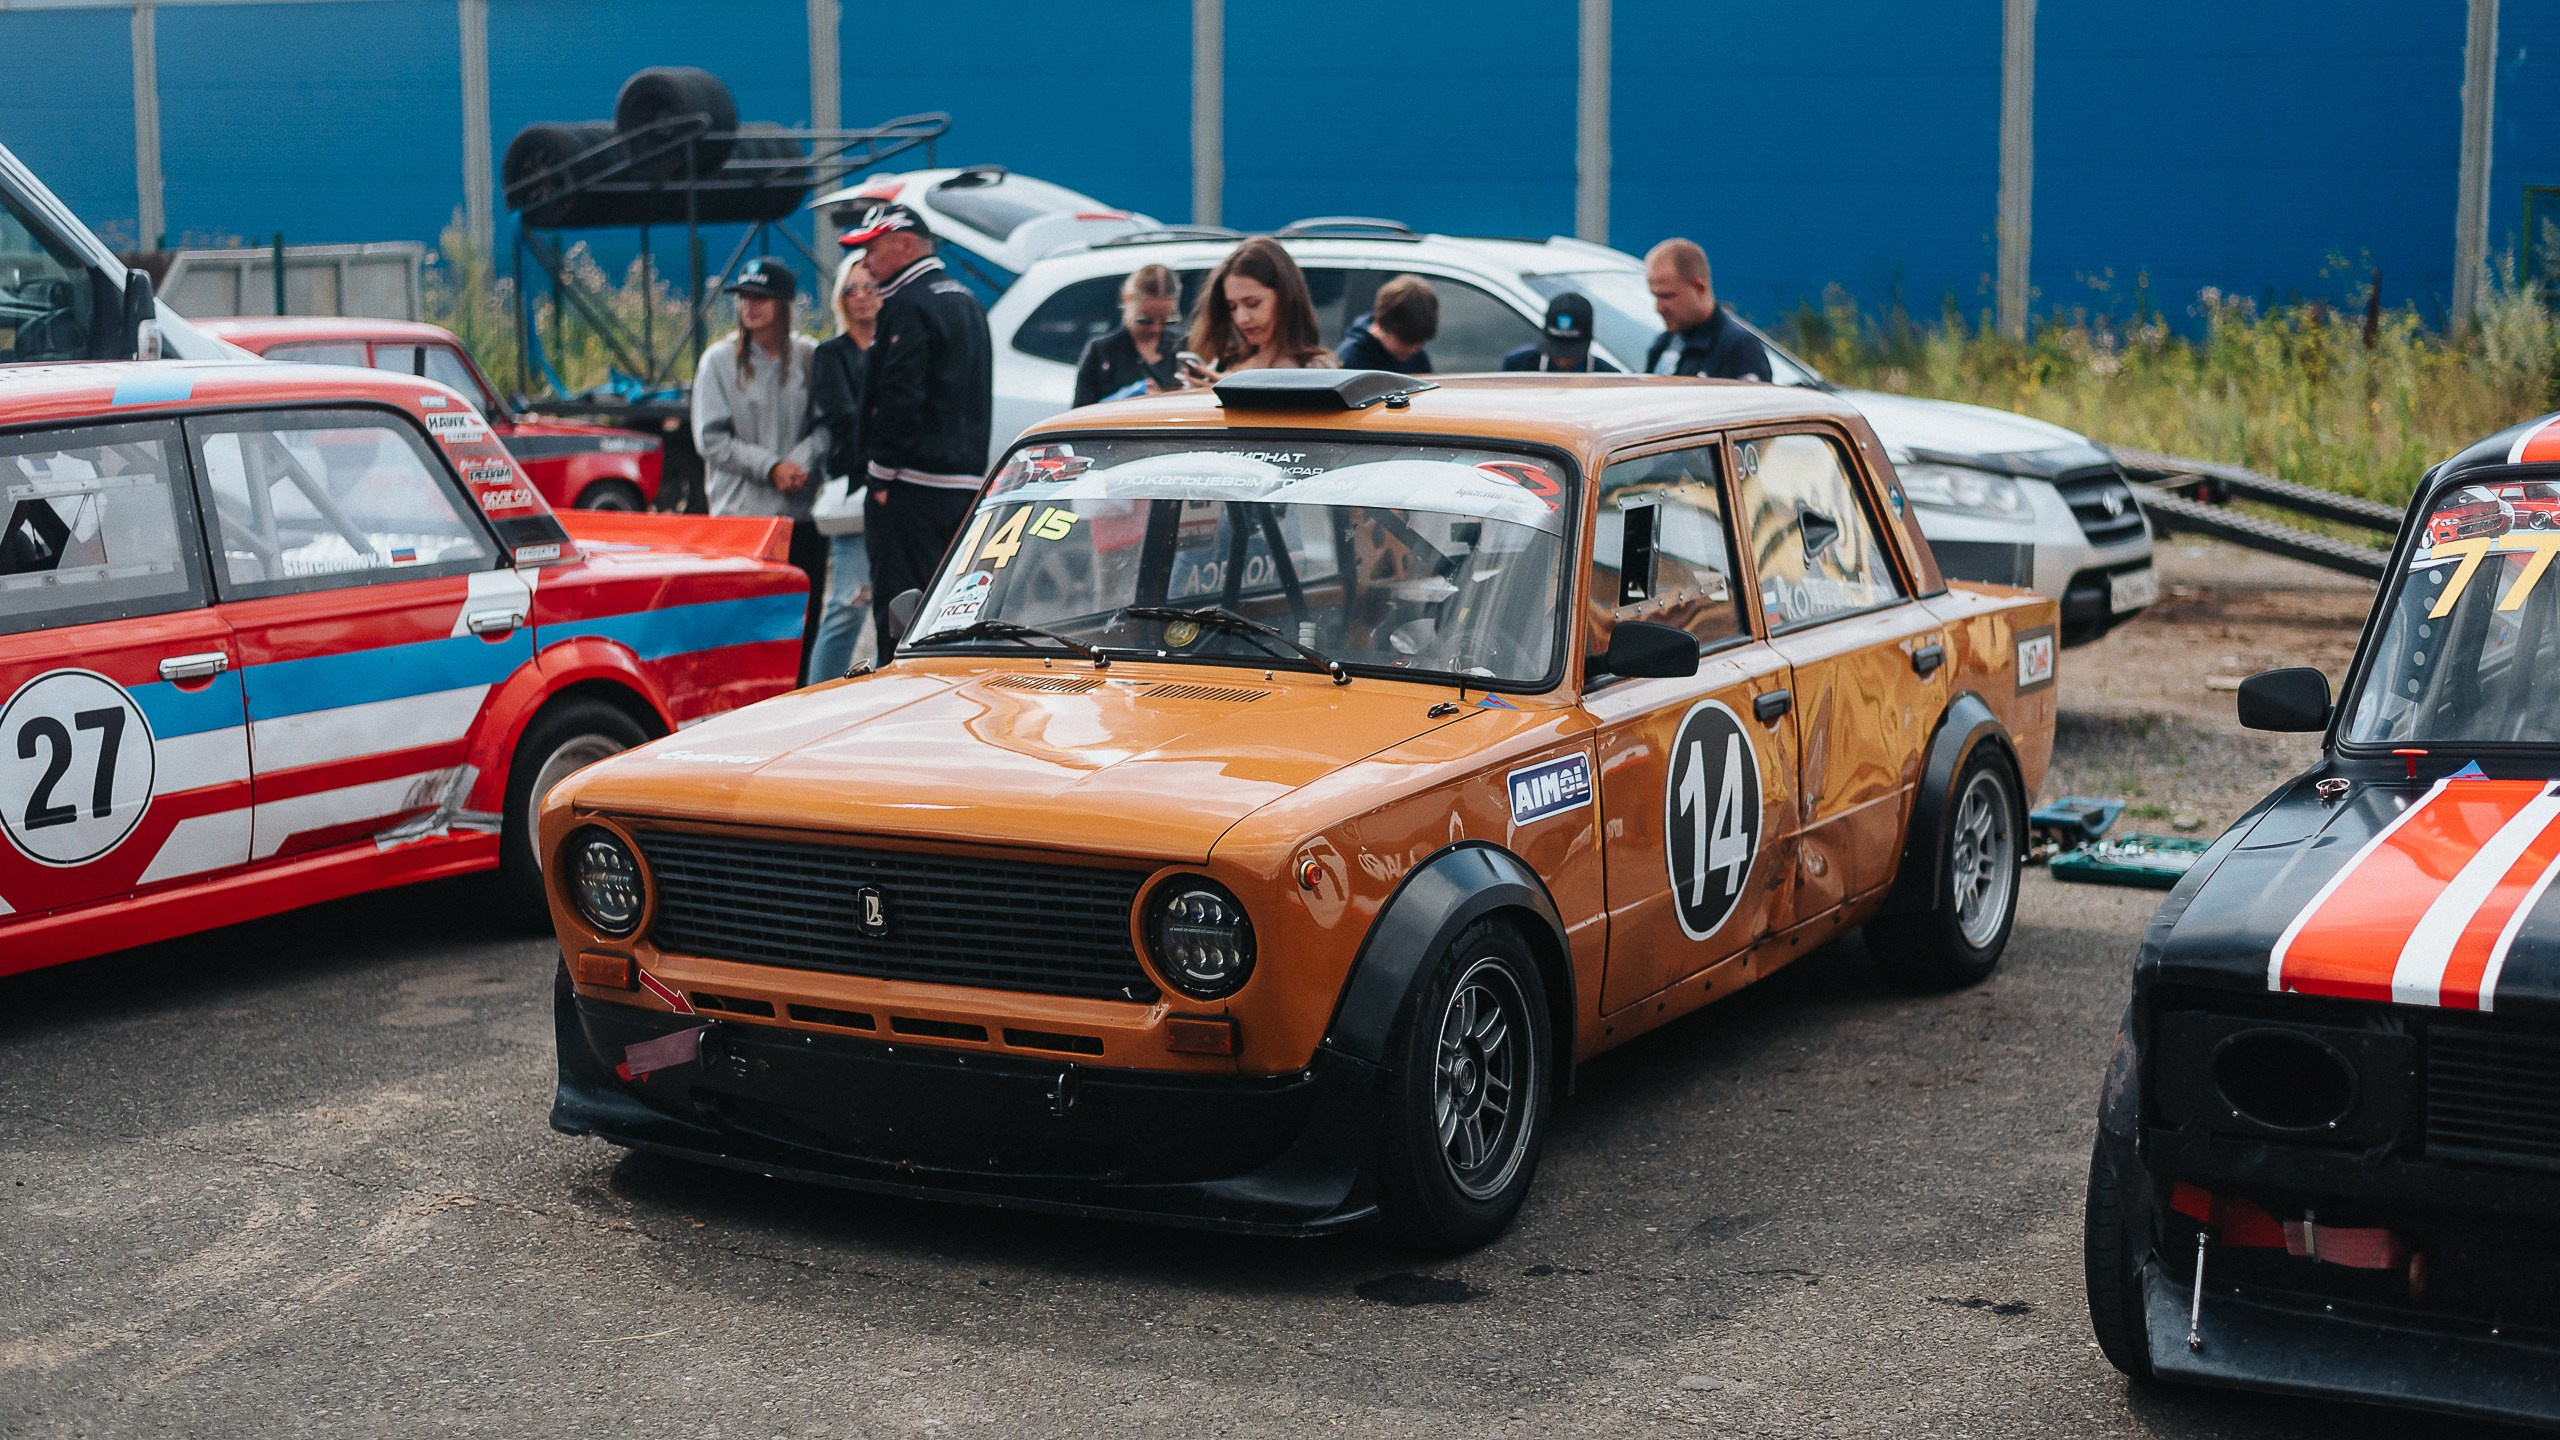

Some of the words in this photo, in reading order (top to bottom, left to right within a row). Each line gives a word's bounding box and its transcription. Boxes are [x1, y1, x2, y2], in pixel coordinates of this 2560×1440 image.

[956, 505, 1034, 576] 14
[2427, 533, 2560, 619] 77
[17, 706, 126, 831] 27
[1515, 765, 1589, 815] AIMOL
[1679, 732, 1748, 907] 14
